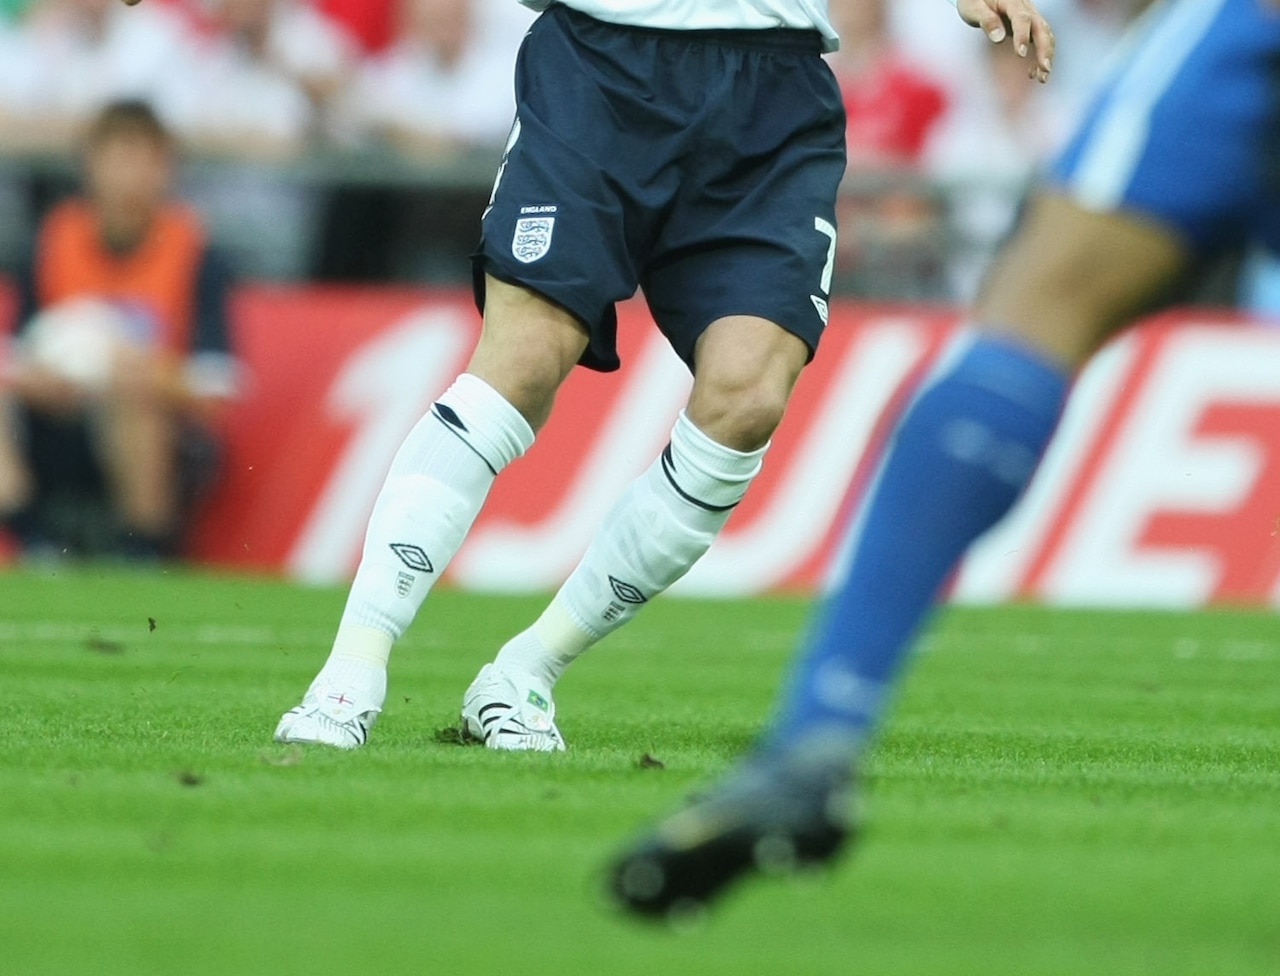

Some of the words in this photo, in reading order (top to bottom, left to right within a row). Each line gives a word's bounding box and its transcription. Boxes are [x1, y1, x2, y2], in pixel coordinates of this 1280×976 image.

[520, 205, 557, 214] ENGLAND
[814, 216, 837, 295] 7
[288, 304, 474, 586] 1
